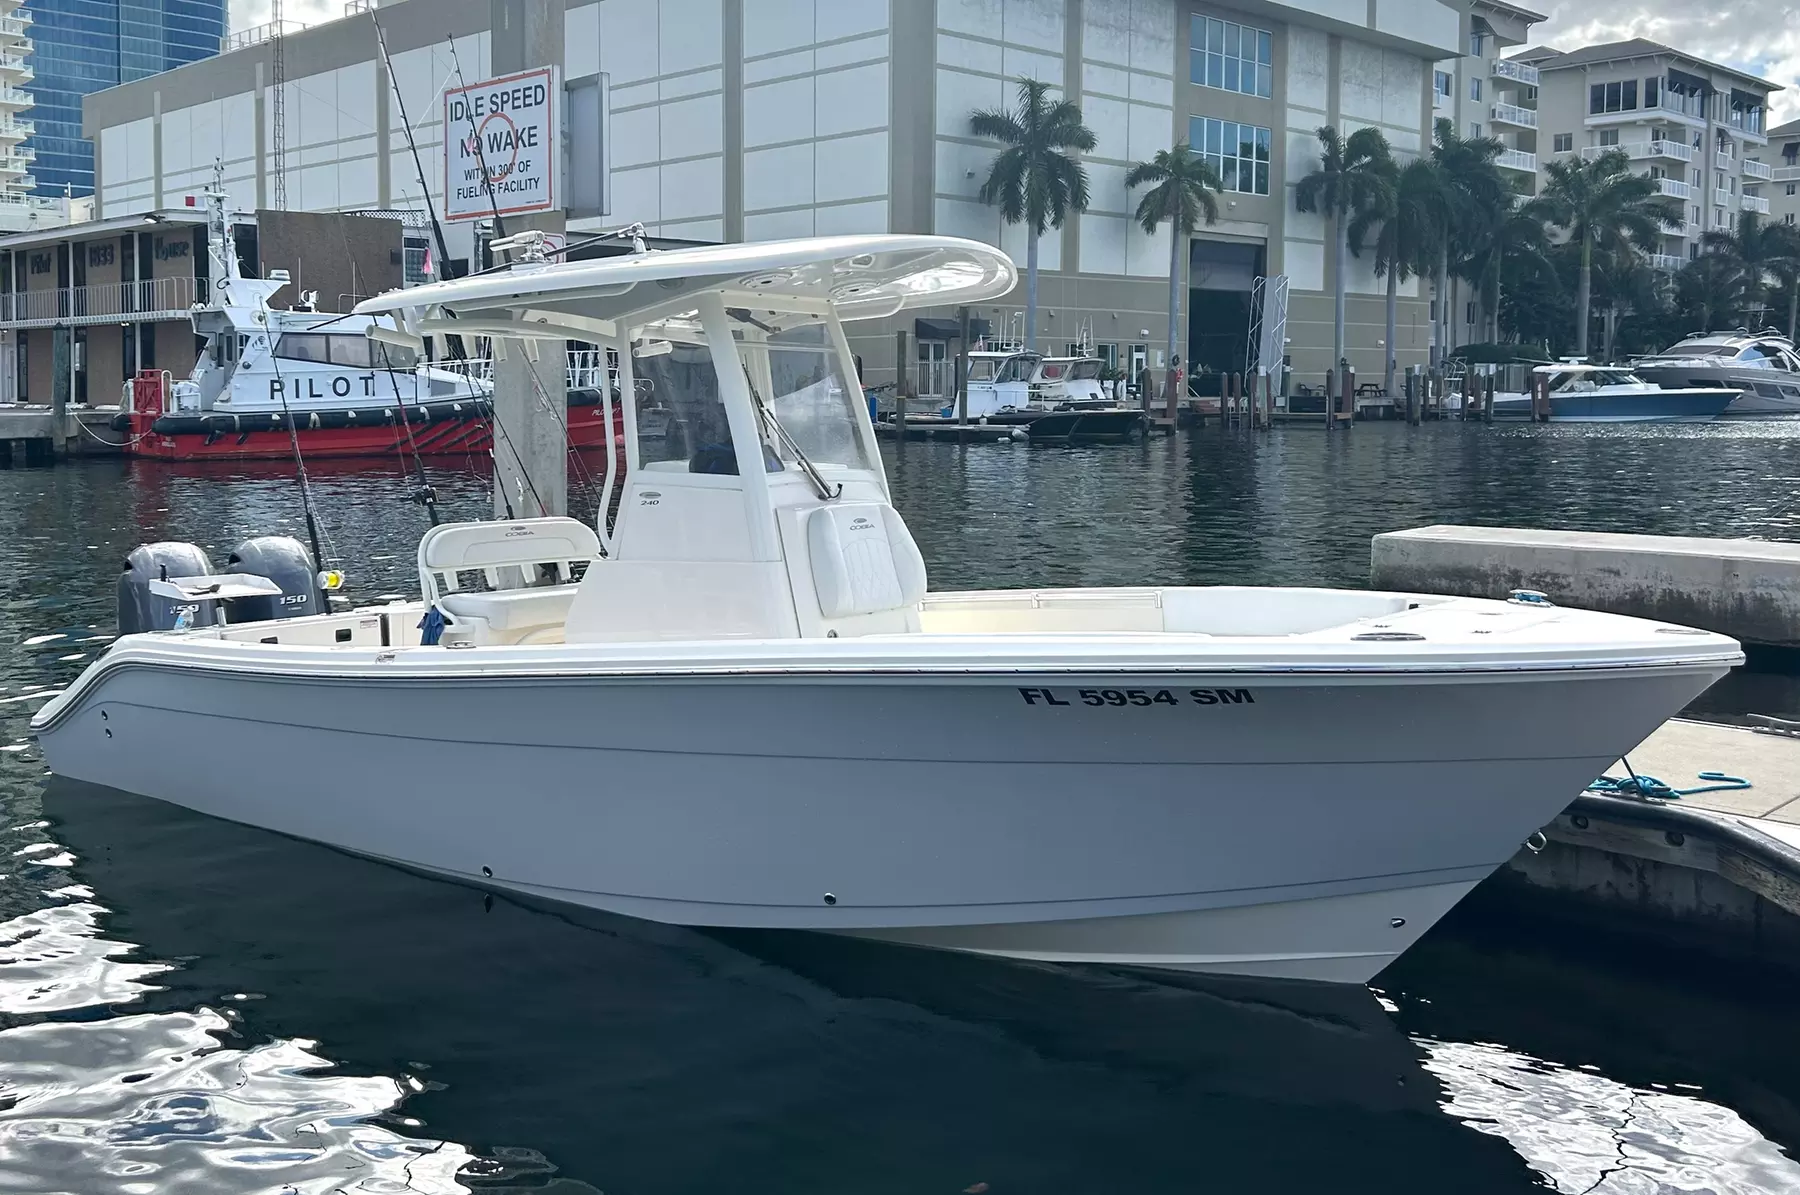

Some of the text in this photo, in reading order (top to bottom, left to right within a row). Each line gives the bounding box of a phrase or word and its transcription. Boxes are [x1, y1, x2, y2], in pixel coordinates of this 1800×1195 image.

[450, 84, 545, 122] IDLE SPEED
[460, 125, 538, 158] NO WAKE
[464, 165, 496, 181] WITHIN
[518, 160, 531, 173] OF
[457, 177, 540, 200] FUELING FACILITY
[271, 376, 374, 399] PILOT
[169, 604, 200, 615] 150
[279, 594, 307, 605] 150
[1017, 687, 1255, 707] FL 5954 SM
